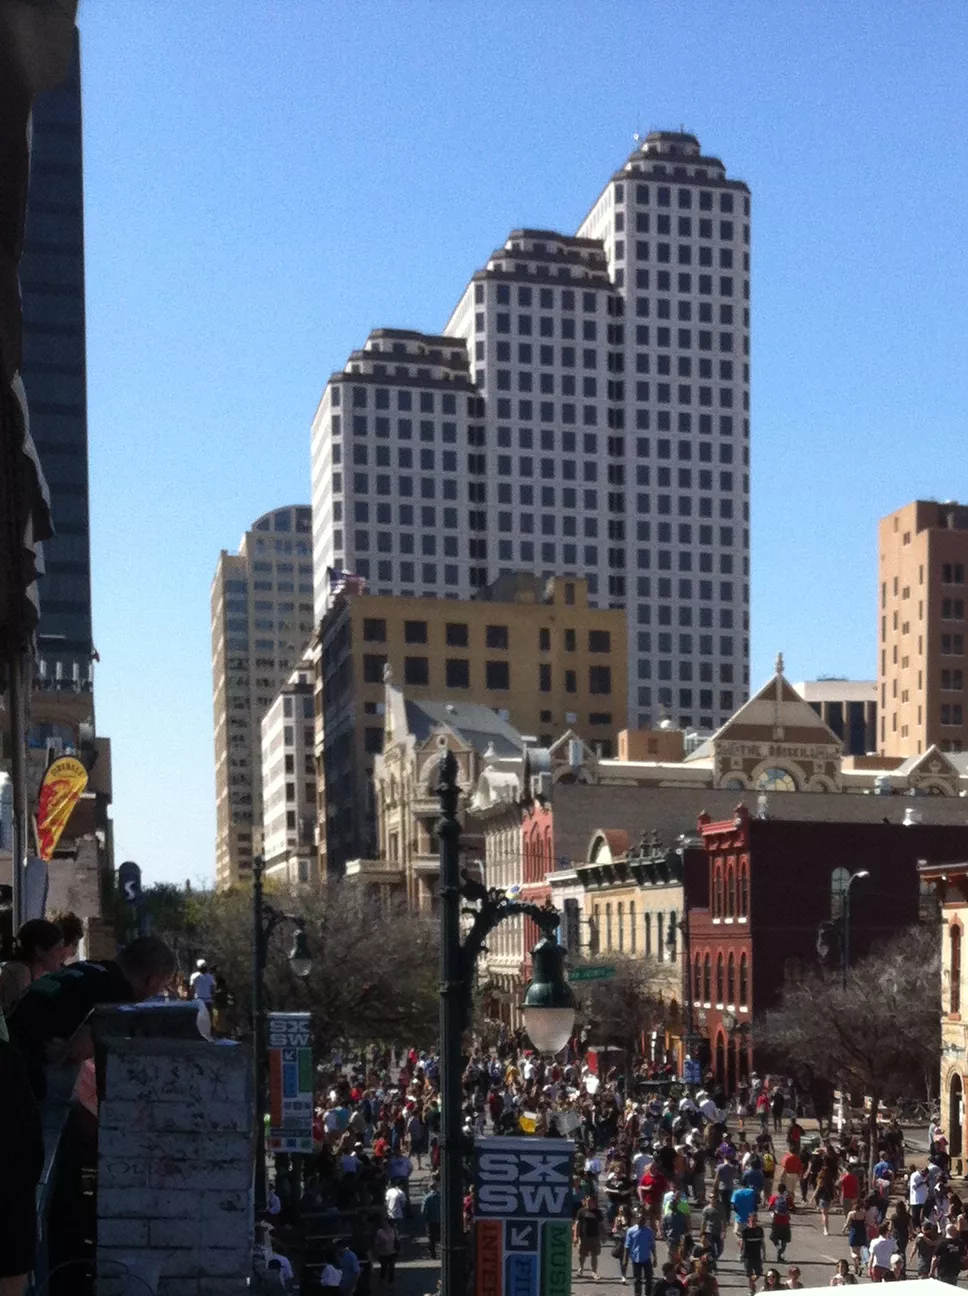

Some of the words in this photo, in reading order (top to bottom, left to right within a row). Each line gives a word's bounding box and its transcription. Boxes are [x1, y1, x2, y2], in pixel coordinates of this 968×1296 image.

[270, 1020, 310, 1034] SX
[269, 1034, 310, 1047] SW
[479, 1154, 569, 1182] SX
[479, 1185, 569, 1213] SW
